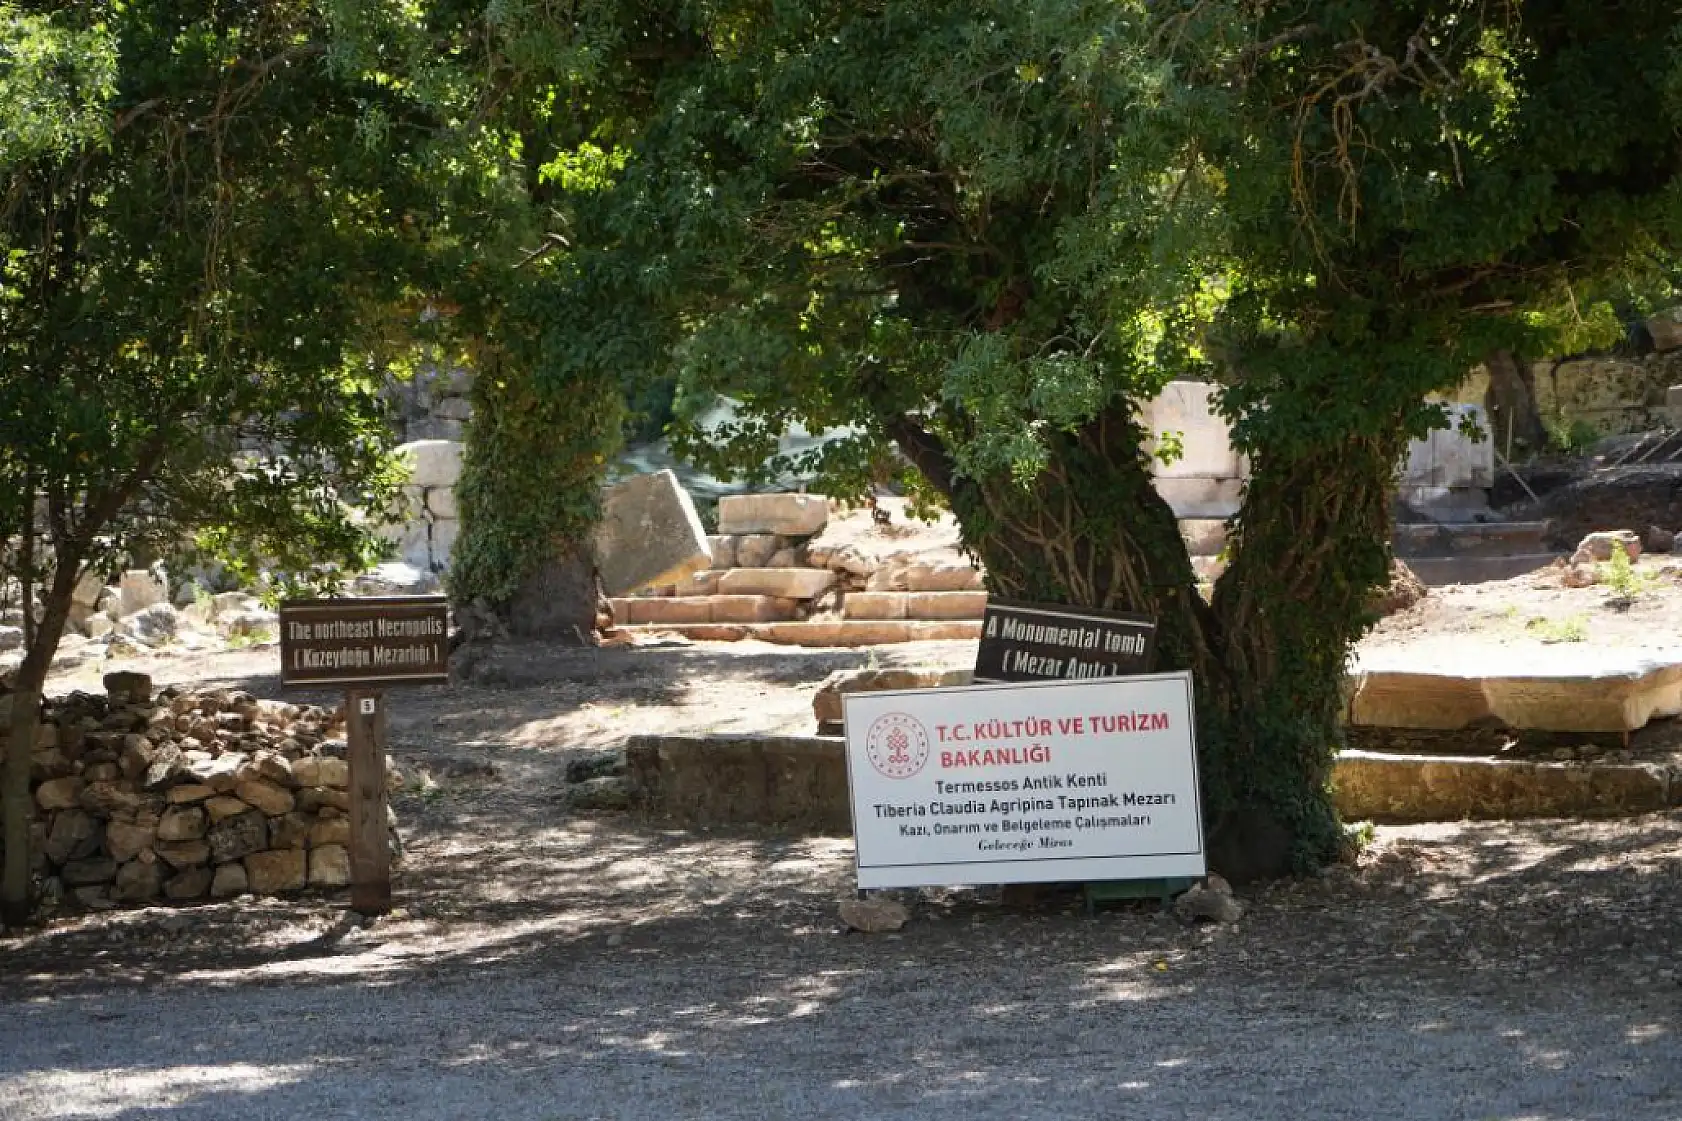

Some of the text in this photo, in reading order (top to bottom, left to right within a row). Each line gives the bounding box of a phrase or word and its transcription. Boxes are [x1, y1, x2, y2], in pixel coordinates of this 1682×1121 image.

[288, 616, 443, 640] The northeast Necropolis
[987, 616, 1145, 655] A Monumental tomb
[1014, 650, 1063, 677] Mezar
[936, 711, 1170, 742] T.C. KÜLTÜR VE TURİZM
[941, 745, 1050, 768] BAKANLIĞI
[935, 772, 1108, 794] Termessos Antik Kenti
[873, 791, 1176, 818] Tiberia Claudia Agripina Tapınak Mezarı
[900, 815, 1151, 837] Kazı, Onarım ve Belgeleme Çalışmaları
